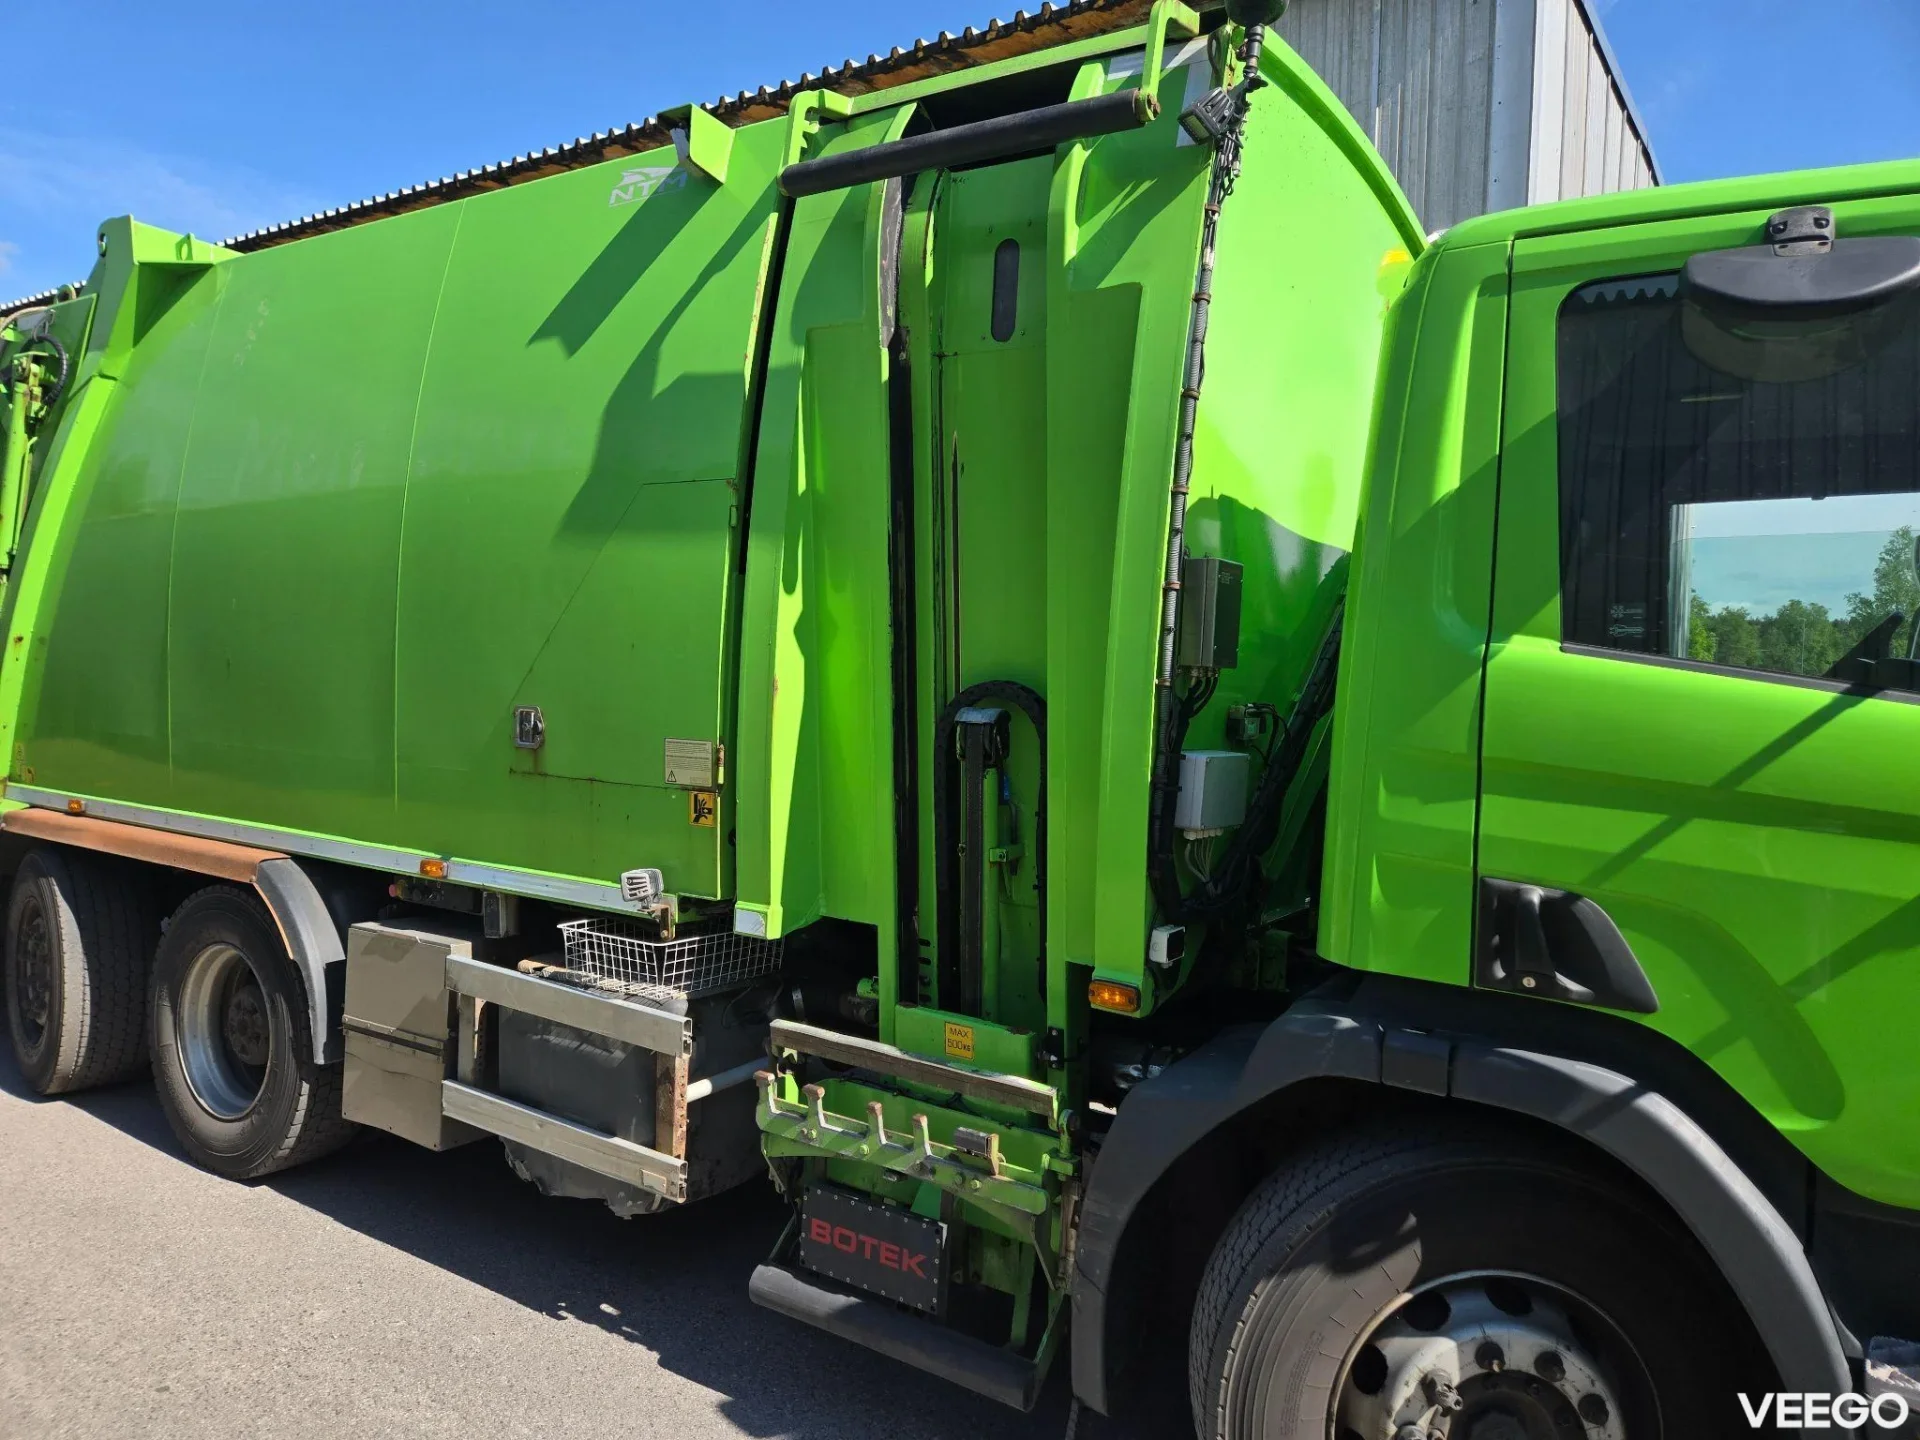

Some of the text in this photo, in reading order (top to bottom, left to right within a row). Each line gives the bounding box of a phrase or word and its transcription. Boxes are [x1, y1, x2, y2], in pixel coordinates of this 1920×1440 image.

[609, 170, 688, 205] NTM
[950, 1027, 969, 1039] MAX
[810, 1218, 928, 1280] BOTEK
